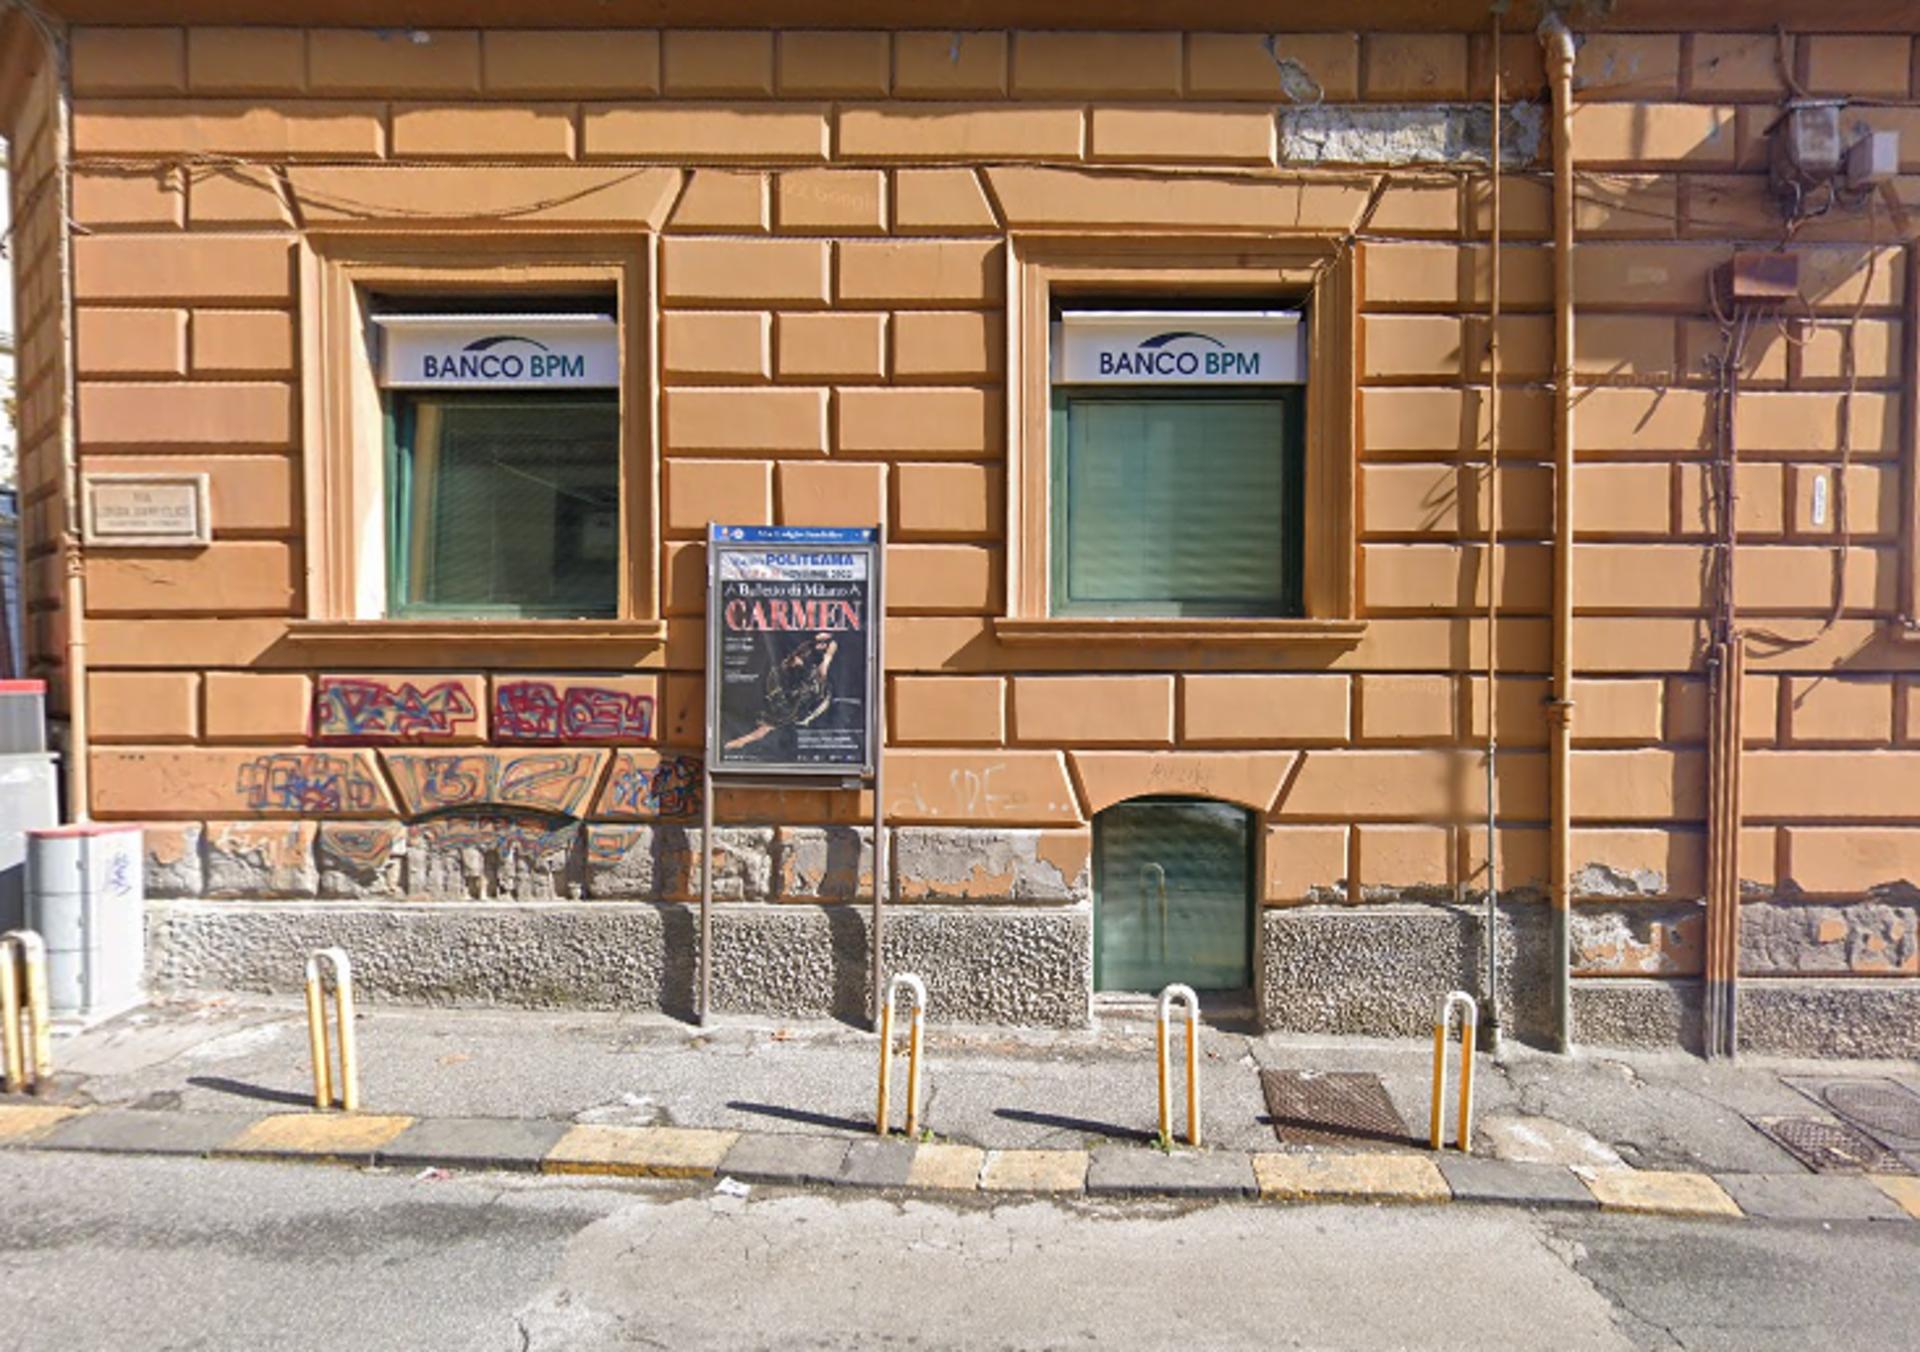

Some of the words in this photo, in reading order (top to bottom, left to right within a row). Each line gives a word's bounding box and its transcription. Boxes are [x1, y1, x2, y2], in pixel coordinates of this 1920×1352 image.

[424, 355, 524, 378] BANCO
[530, 355, 584, 377] BPM
[1100, 352, 1199, 375] BANCO
[1206, 352, 1260, 374] BPM
[766, 553, 854, 566] POLITEAMA
[725, 599, 862, 631] CARMEN
